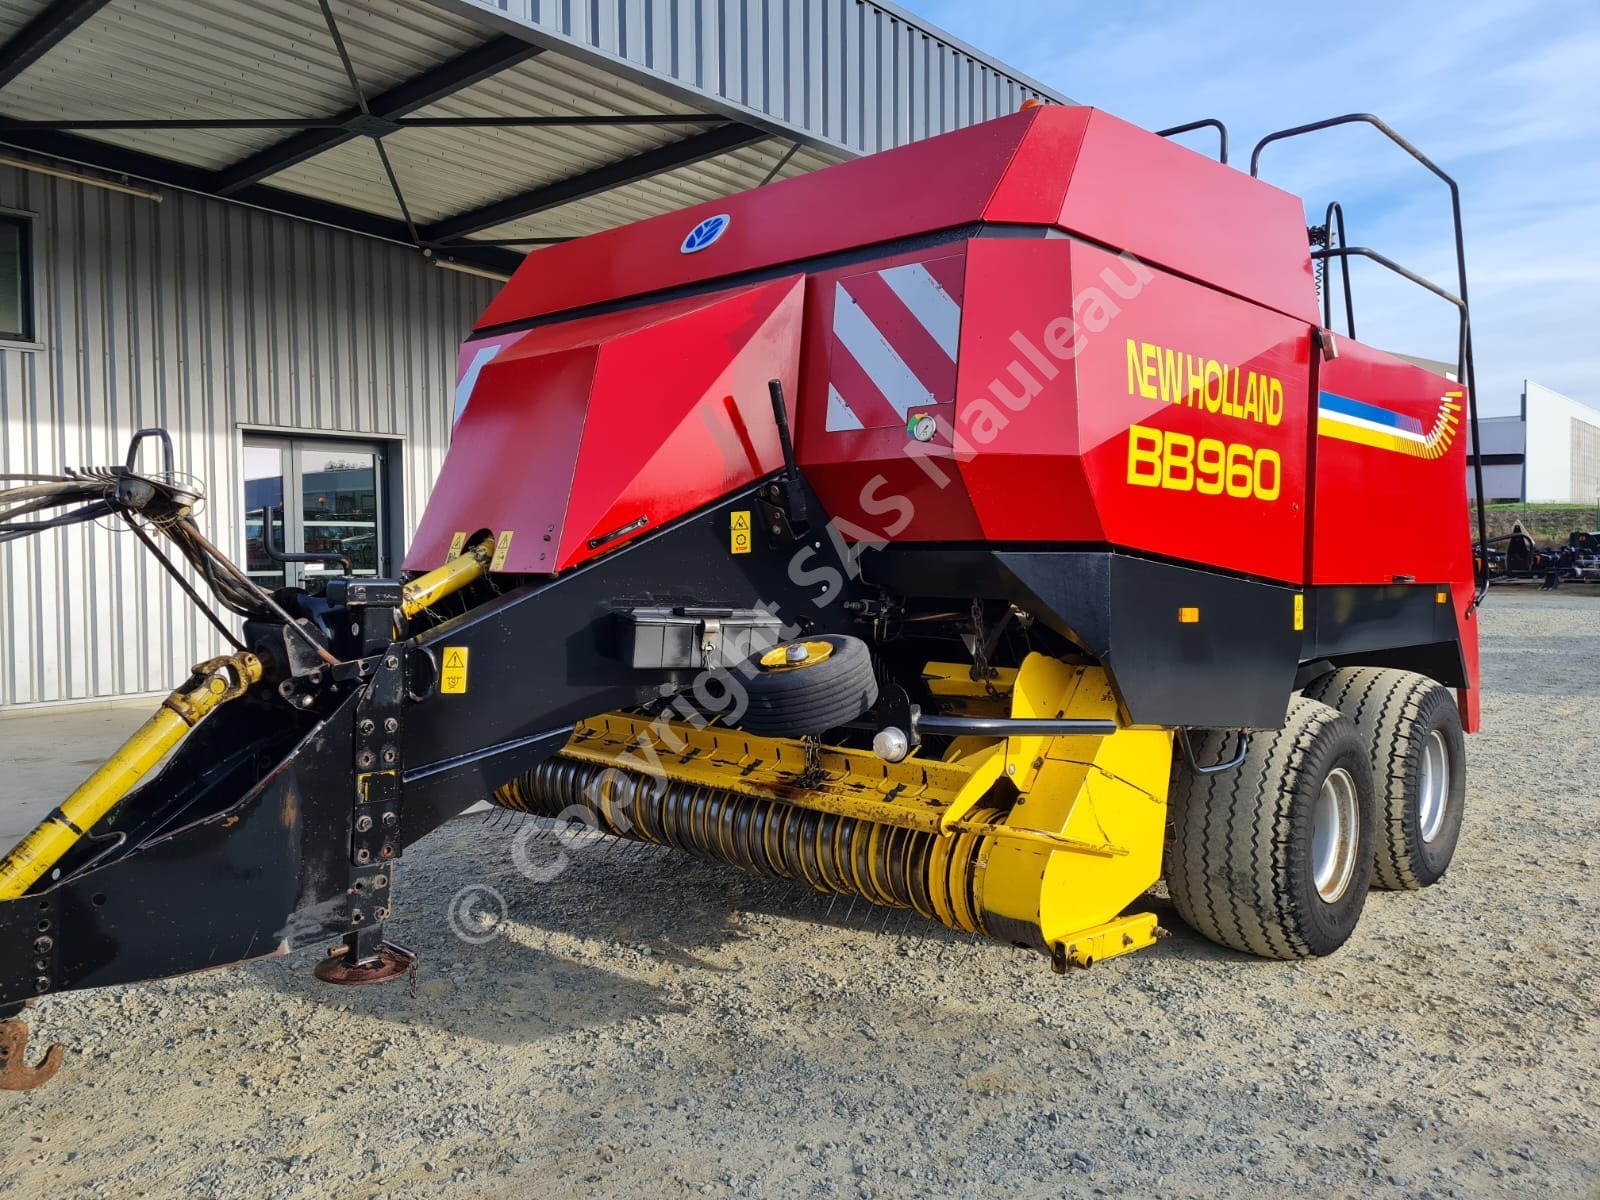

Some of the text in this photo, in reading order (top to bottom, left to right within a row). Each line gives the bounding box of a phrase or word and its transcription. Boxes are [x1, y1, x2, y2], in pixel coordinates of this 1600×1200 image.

[1126, 338, 1284, 427] NEW HOLLAND
[1126, 424, 1281, 502] BB960
